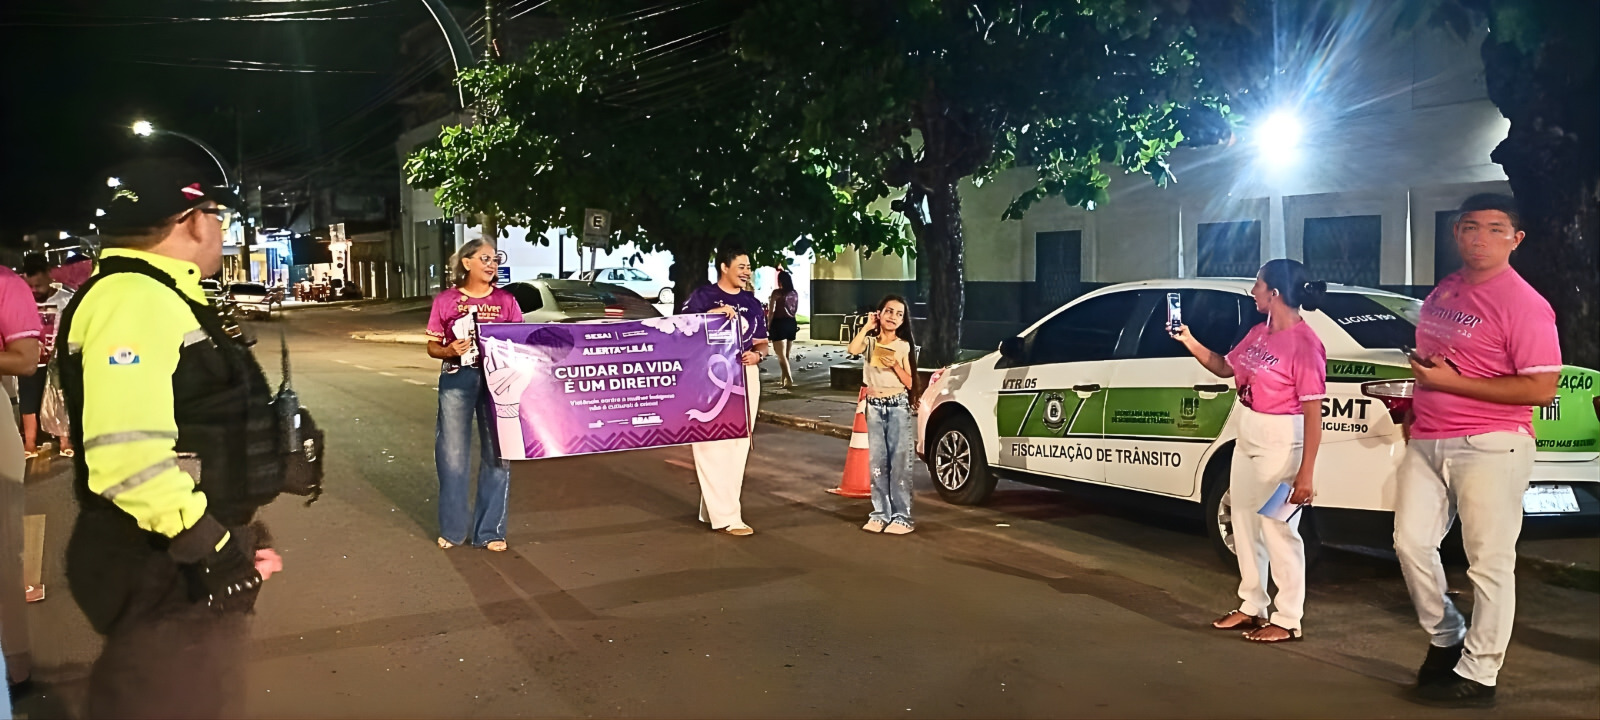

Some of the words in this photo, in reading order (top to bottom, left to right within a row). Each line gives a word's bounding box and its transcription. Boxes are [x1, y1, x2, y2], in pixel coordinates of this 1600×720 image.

[593, 215, 603, 228] E
[1337, 314, 1376, 325] LIGUE
[584, 332, 612, 340] SESAI
[582, 346, 621, 356] ALERTA
[626, 342, 654, 354] LILÁS
[554, 364, 619, 379] CUIDAR
[622, 362, 645, 375] DA
[646, 360, 683, 373] VIDA
[564, 378, 576, 394] É
[578, 379, 606, 392] UM
[609, 374, 677, 390] DIREITO!
[1002, 378, 1022, 389] VTR
[1024, 378, 1038, 389] 05
[1321, 421, 1368, 433] IGUE:190
[1011, 443, 1093, 462] FISCALIZAÇÃO
[1096, 448, 1112, 462] DE
[1115, 446, 1182, 467] TRÂNSITO
